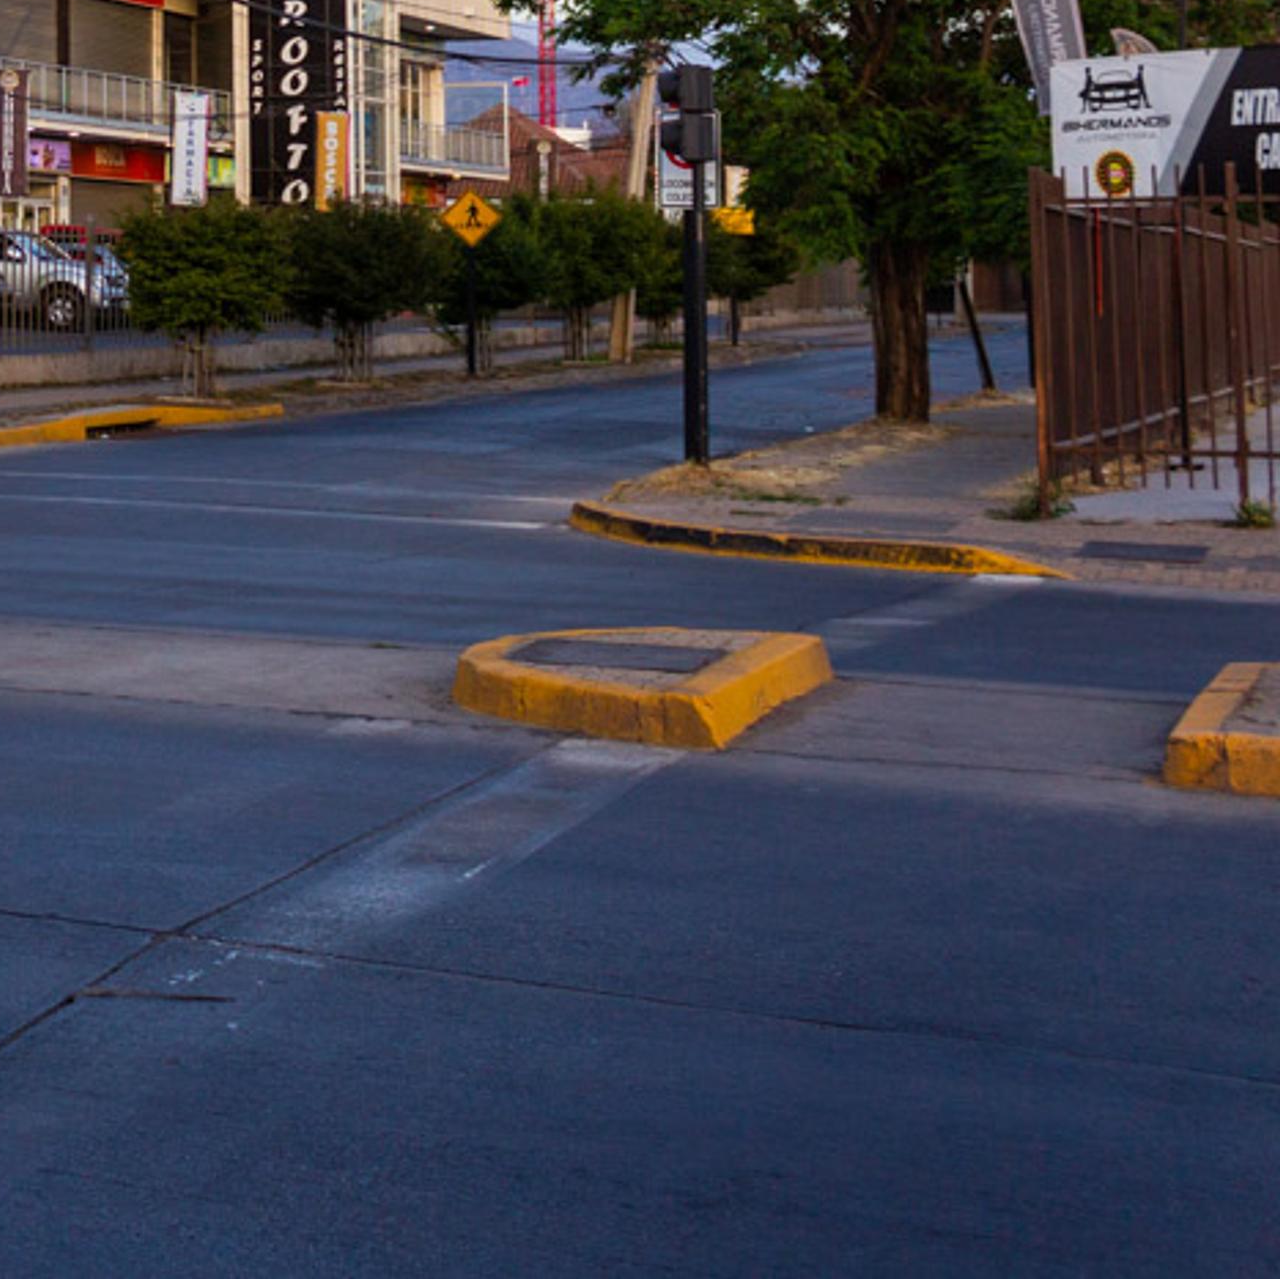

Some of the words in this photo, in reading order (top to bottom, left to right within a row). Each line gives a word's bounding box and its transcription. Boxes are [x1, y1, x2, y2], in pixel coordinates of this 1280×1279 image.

[251, 39, 264, 115] SPORT
[333, 39, 346, 107] RESTA
[1231, 88, 1280, 126] ENTR
